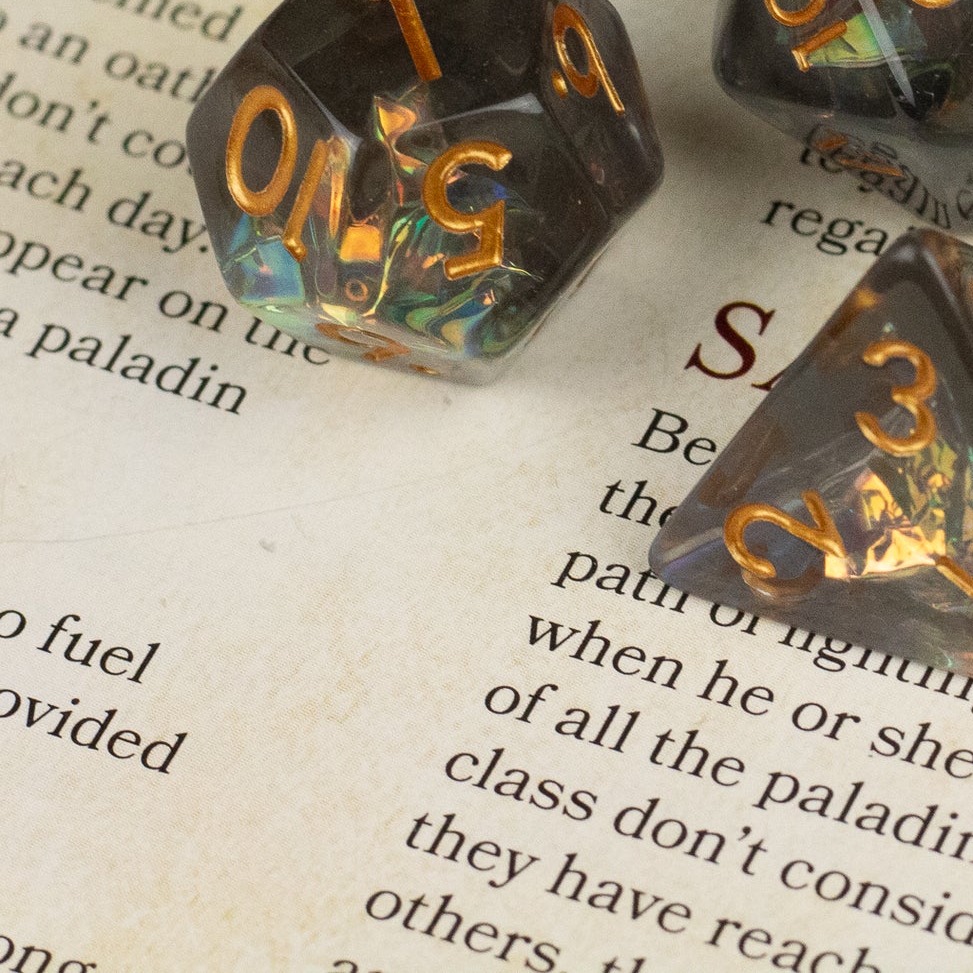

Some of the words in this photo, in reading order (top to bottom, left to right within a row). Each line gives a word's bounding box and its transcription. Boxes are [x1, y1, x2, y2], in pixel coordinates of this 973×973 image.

[18, 20, 92, 66] an
[106, 189, 209, 254] day.
[421, 139, 514, 282] 5
[157, 289, 230, 334] on
[26, 323, 248, 415] paladin
[855, 340, 938, 457] 3
[722, 490, 850, 579] 2
[36, 613, 161, 684] fuel
[528, 614, 684, 690] when
[698, 658, 775, 716] he
[791, 702, 862, 741] or
[483, 682, 560, 725] of
[554, 704, 641, 753] all
[649, 729, 746, 787] the
[444, 747, 599, 821] class
[612, 797, 768, 877] don't
[405, 813, 540, 889] they
[547, 852, 692, 932] have
